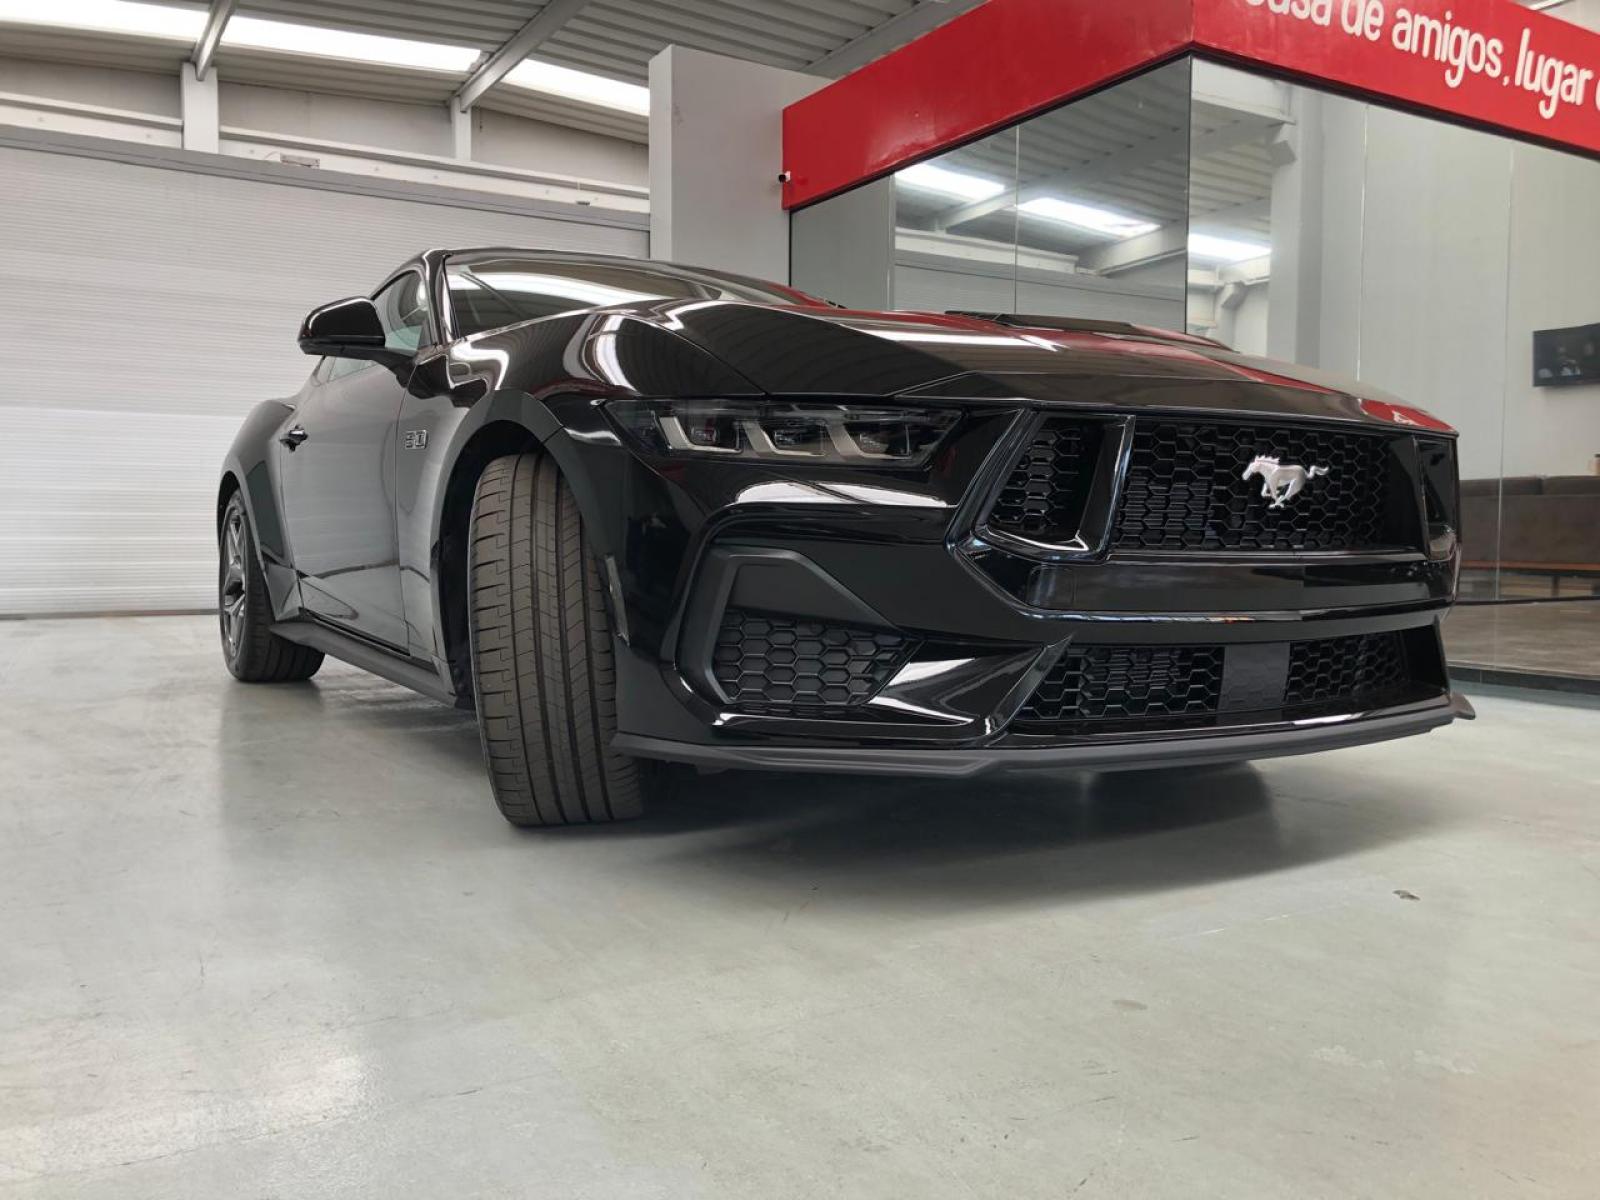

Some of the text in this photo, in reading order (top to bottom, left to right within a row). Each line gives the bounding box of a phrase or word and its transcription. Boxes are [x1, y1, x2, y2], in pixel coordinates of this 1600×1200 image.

[1341, 0, 1385, 41] de
[1391, 8, 1510, 88] amigos,
[1514, 27, 1594, 119] lugar
